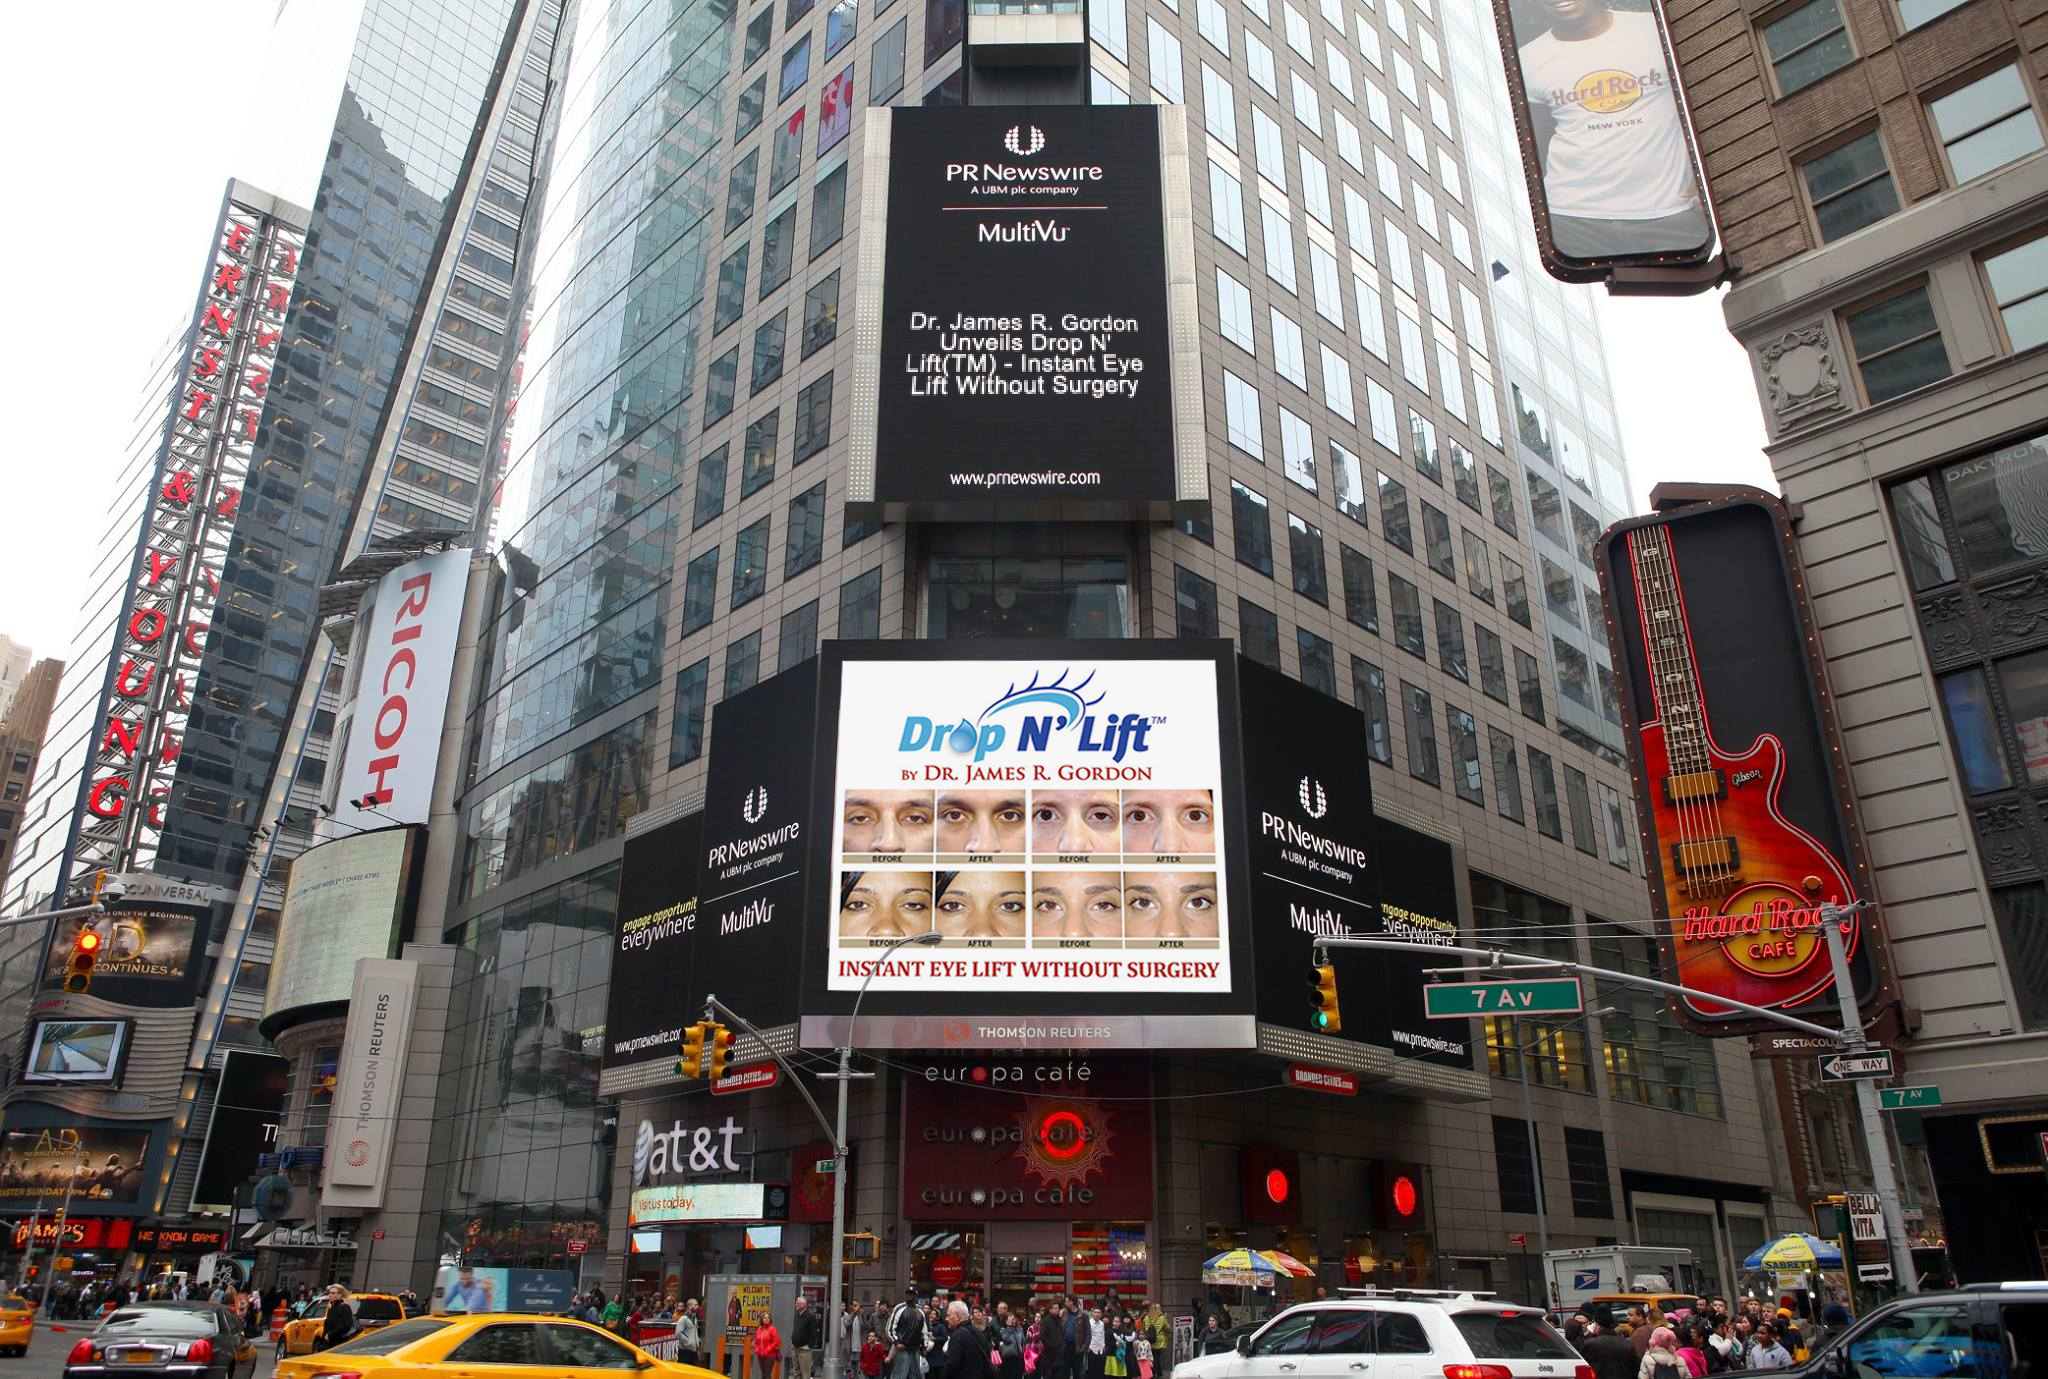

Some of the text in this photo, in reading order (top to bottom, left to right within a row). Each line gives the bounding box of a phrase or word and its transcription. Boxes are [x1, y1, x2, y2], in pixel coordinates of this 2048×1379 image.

[1551, 67, 1663, 106] Hard Rock
[1587, 118, 1644, 131] NEW YORK
[946, 163, 1103, 182] PR Newswire
[970, 185, 1079, 197] A UBM plc company
[978, 219, 1067, 243] MultiVu
[910, 311, 1139, 332] Dr. James R. Gordon
[940, 332, 1112, 357] Unveils Drop N'
[906, 353, 997, 377] Lift(TM)
[1021, 353, 1097, 373] Instant
[1103, 353, 1144, 377] Eye
[911, 375, 1139, 399] Lift Without Surgery
[949, 469, 1101, 489] www.prnewswire.com
[89, 551, 177, 817] YOUNG
[362, 571, 432, 808] RICOH
[898, 715, 1007, 763] Drop
[1077, 712, 1153, 764] Lift
[901, 764, 1153, 785] BY DR. JAMES R. GORDON
[728, 822, 800, 862] Newswire
[1287, 820, 1366, 869] Newswire
[726, 863, 742, 878] UBM
[742, 860, 753, 875] plc
[753, 851, 784, 869] company
[872, 855, 903, 863] BEFORE
[968, 855, 993, 863] AFTER
[1058, 855, 1090, 863] BEFORE
[1155, 855, 1181, 863] AFTER
[1280, 848, 1353, 884] A UBM plc company
[126, 883, 210, 902] CUNIVERSAL
[622, 895, 698, 933] engage opportunit
[1381, 903, 1457, 939] ngage opportunity
[1684, 902, 1763, 941] Hard
[621, 913, 696, 951] everywhere
[869, 939, 900, 948] BEFORE
[967, 939, 993, 948] AFTER
[1059, 939, 1092, 948] BEFORE
[1158, 939, 1185, 948] AFTER
[1747, 941, 1797, 959] CAFE
[93, 963, 168, 975] CONTINUES
[838, 960, 1220, 979] INSTANT EYE LIFT WITHOUT SURGERY
[1471, 989, 1487, 1008] 7
[614, 1028, 681, 1055] www.prnewswire.co
[978, 1026, 1112, 1039] THOMSON REUTERS
[356, 993, 390, 1132] THOMSON REUTERS
[1833, 1058, 1884, 1073] ONE WAY
[1295, 1069, 1323, 1085] BRANDED
[1893, 1089, 1923, 1106] 7 AV
[650, 1115, 744, 1177] at&t
[25, 1187, 65, 1197] SUNDAY
[663, 1195, 695, 1210] today.
[1849, 1193, 1881, 1215] BELLA
[138, 1231, 219, 1242] WE KNOW GAME
[268, 1227, 353, 1247] CHASE
[1853, 1217, 1877, 1238] VITA
[742, 1295, 770, 1307] FLAVOR
